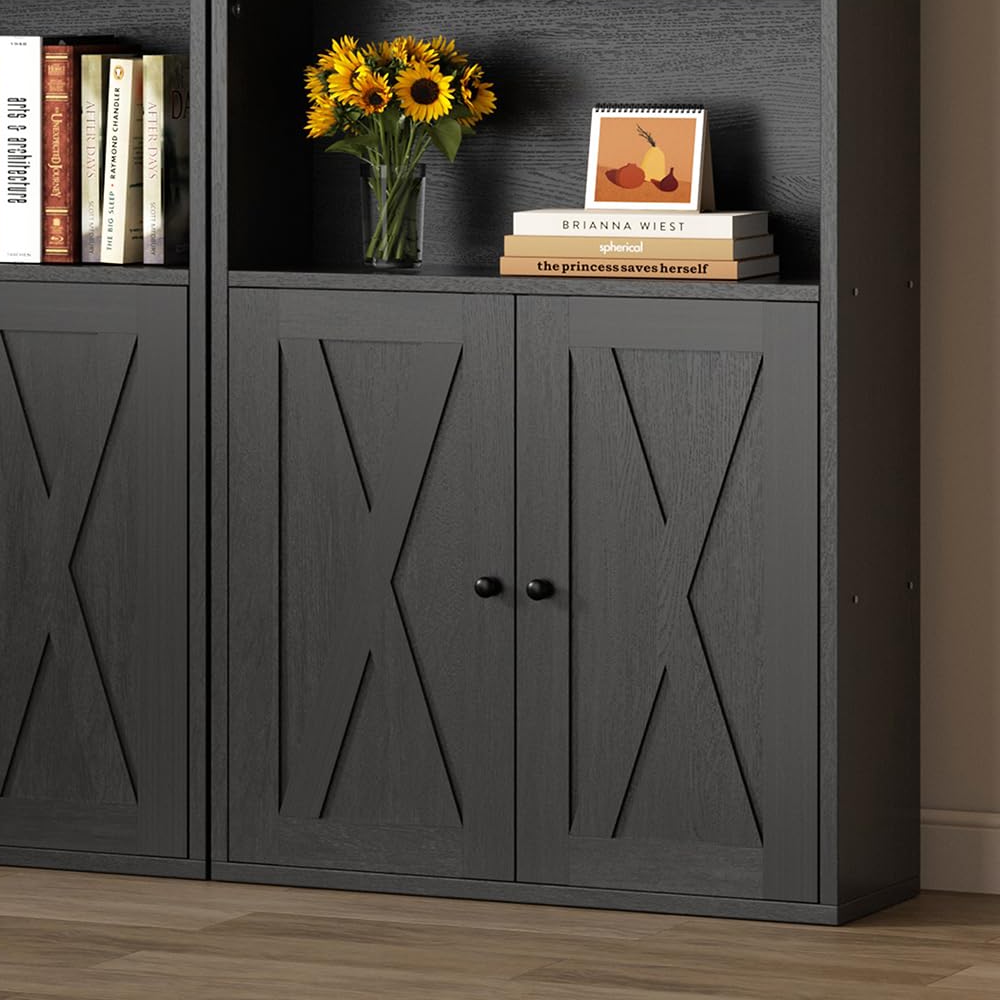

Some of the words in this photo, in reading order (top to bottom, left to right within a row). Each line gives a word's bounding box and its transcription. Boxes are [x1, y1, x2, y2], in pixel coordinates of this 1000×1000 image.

[7, 98, 30, 119] arts
[113, 88, 121, 133] CHANDLER
[7, 138, 32, 204] architecture
[85, 146, 96, 180] DAYS
[147, 147, 158, 181] DAYS
[562, 220, 632, 231] BRIANNA
[640, 222, 685, 232] WIEST
[599, 241, 644, 255] spherical
[537, 261, 559, 272] the
[562, 262, 619, 275] princess
[620, 265, 659, 273] saves
[660, 263, 709, 274] herself
